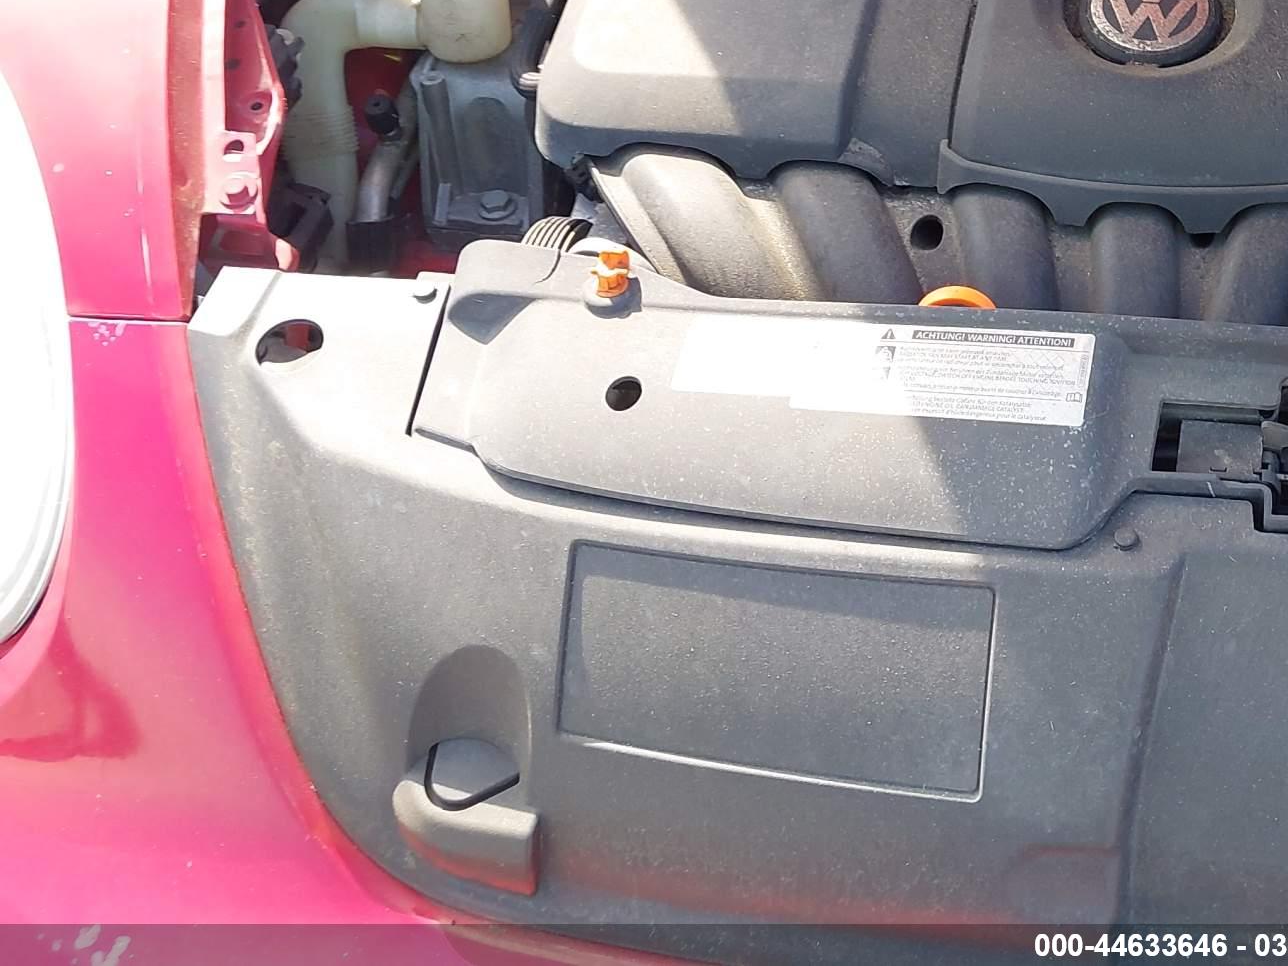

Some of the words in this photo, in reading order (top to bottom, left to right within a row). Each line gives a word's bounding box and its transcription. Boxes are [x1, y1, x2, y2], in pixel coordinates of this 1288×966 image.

[915, 331, 966, 341] ACHTUNG!
[967, 333, 1016, 344] WARNING!
[1017, 336, 1072, 347] ATTENTION!
